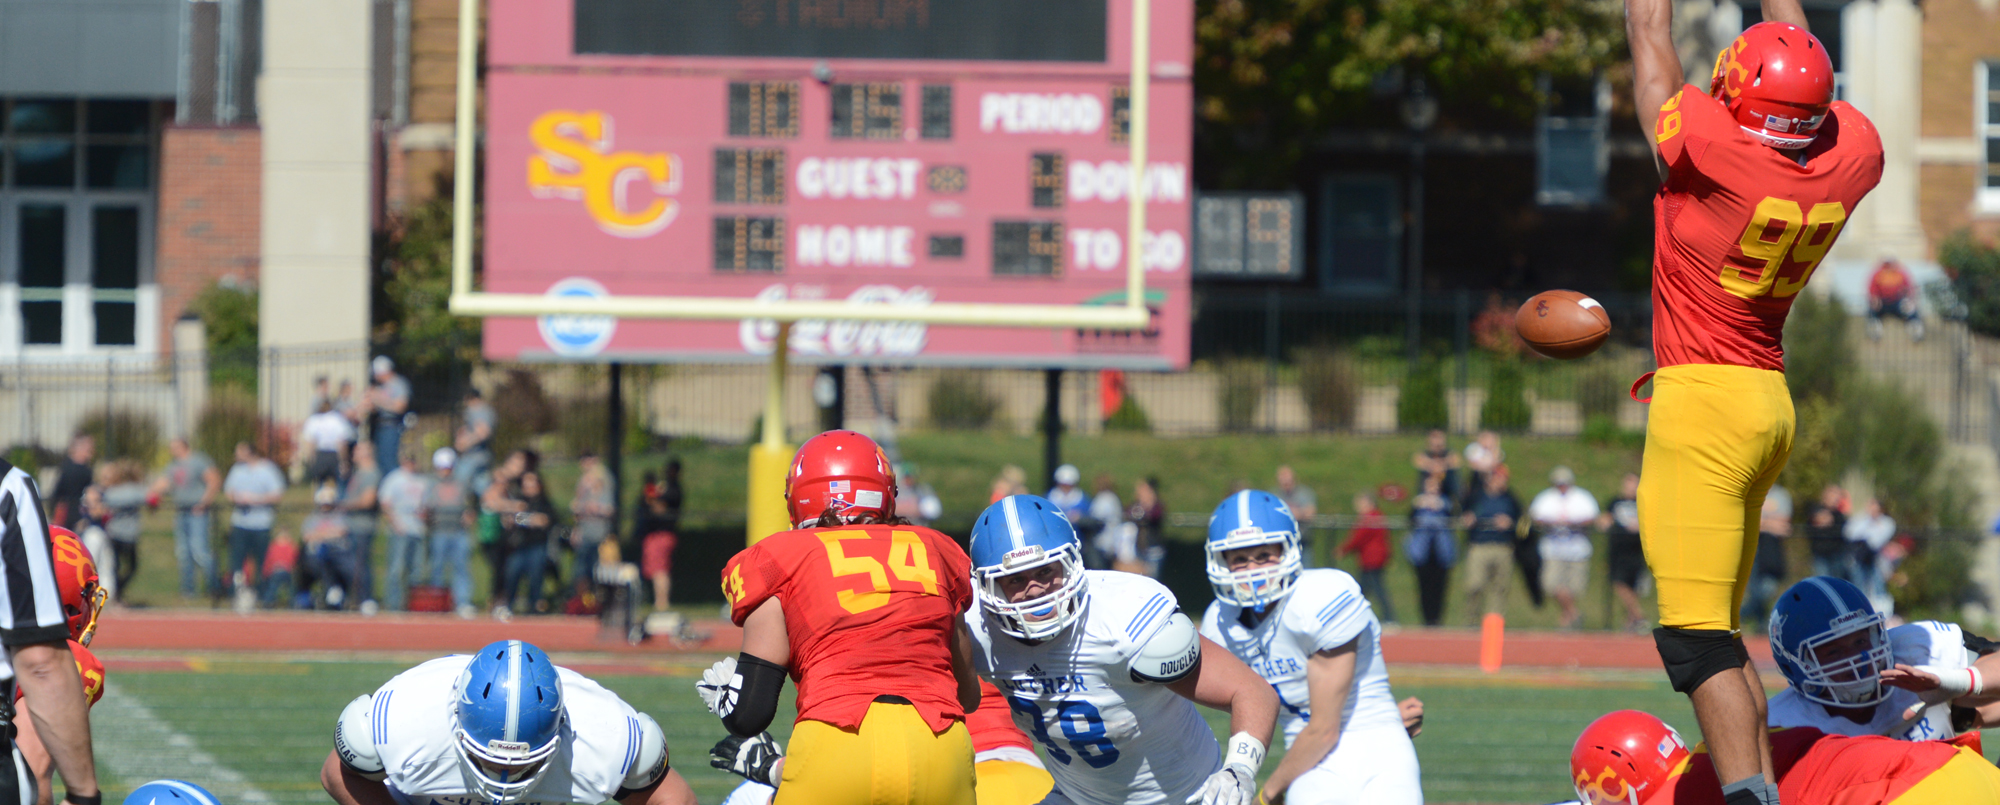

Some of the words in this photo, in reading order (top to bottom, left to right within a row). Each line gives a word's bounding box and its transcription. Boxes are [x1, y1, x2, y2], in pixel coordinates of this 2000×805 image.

[979, 93, 1103, 133] PERIOD
[528, 110, 683, 238] SC
[797, 157, 921, 199] GUEST
[1068, 160, 1186, 203] DOWN
[796, 224, 914, 267] HOME
[1068, 229, 1122, 271] TO
[1719, 196, 1846, 299] 99
[814, 529, 942, 615] 54
[1010, 547, 1034, 560] Riddell
[1160, 643, 1197, 676] DOUGLAS
[1002, 675, 1088, 694] LUTHER
[336, 720, 358, 762] DOUGLAS
[497, 743, 521, 751] Riddell
[1236, 741, 1262, 765] BN
